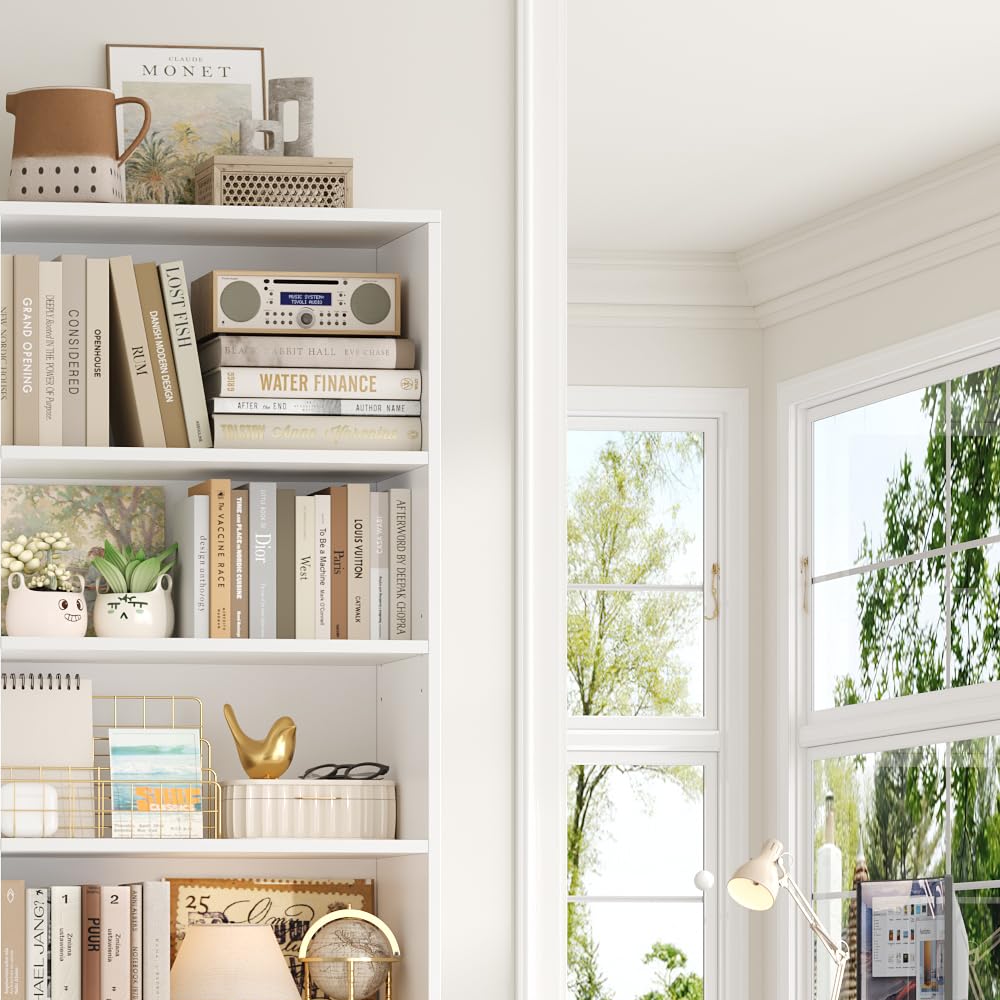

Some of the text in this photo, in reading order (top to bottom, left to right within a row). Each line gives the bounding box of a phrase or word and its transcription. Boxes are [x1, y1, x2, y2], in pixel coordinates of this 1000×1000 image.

[142, 64, 232, 78] MONET
[46, 295, 54, 318] DEEPLY
[166, 266, 192, 348] LOST FISH
[22, 298, 32, 393] GRAND OPENING
[46, 348, 54, 360] THE
[68, 309, 80, 395] CONSIDERED
[150, 311, 174, 403] DANISH MODERN DESIGN
[308, 348, 336, 356] HALL
[132, 345, 148, 376] RUM
[46, 362, 54, 385] POWER
[260, 374, 376, 393] WATER FINANCE
[46, 386, 54, 396] OF
[320, 528, 326, 537] To
[320, 539, 326, 548] Be
[198, 535, 207, 565] design
[255, 533, 272, 564] Dior
[354, 520, 363, 579] LOUIS VUITTON
[300, 556, 311, 580] West
[334, 551, 344, 575] Paris
[396, 500, 406, 634] AFTERWORD BY DEEPAK CHOPRA
[62, 895, 68, 904] 1
[110, 894, 119, 905] 2
[186, 896, 210, 915] 25
[34, 900, 44, 954] JANG?
[88, 918, 100, 952] PUUR
